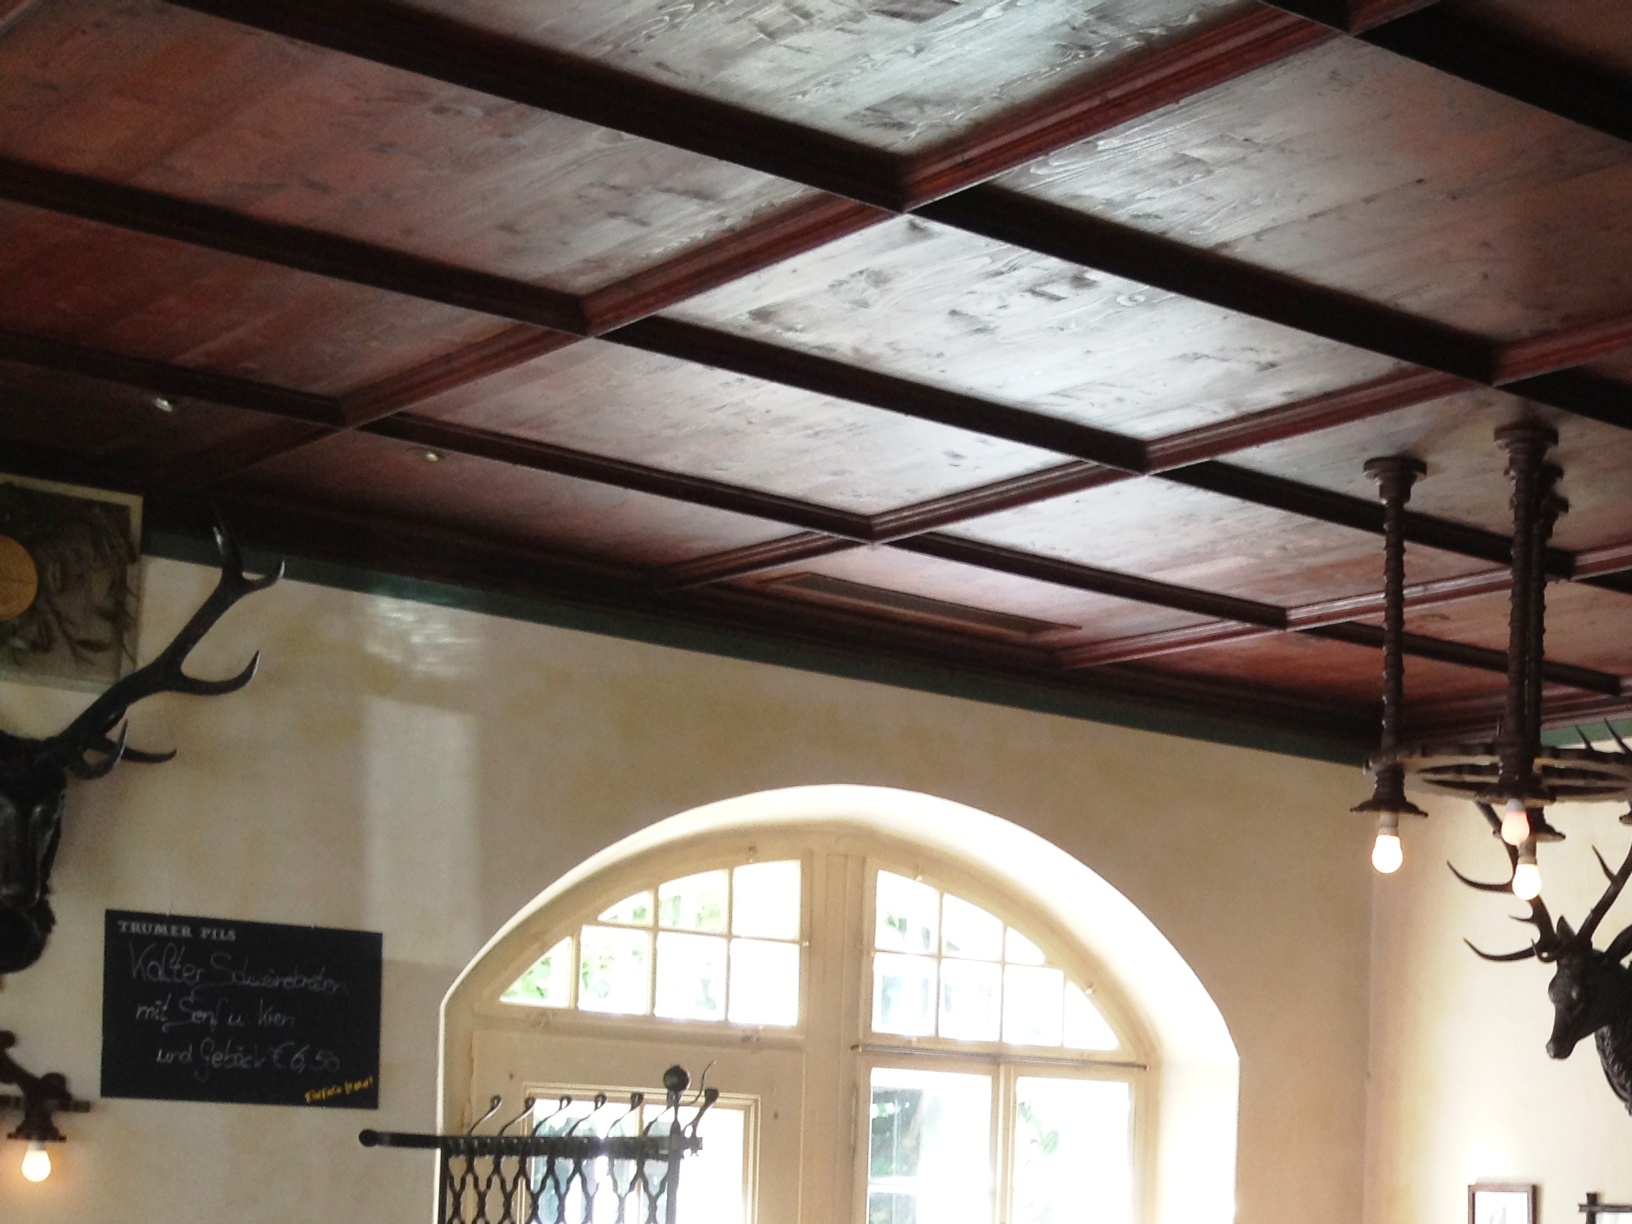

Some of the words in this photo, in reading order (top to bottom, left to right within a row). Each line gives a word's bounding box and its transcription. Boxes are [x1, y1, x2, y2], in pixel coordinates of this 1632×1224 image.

[117, 920, 192, 938] TRUMER
[199, 923, 236, 941] PILS
[128, 941, 204, 985] Kalter
[136, 992, 171, 1020] mit
[162, 996, 227, 1033] Senf
[156, 1045, 193, 1064] und
